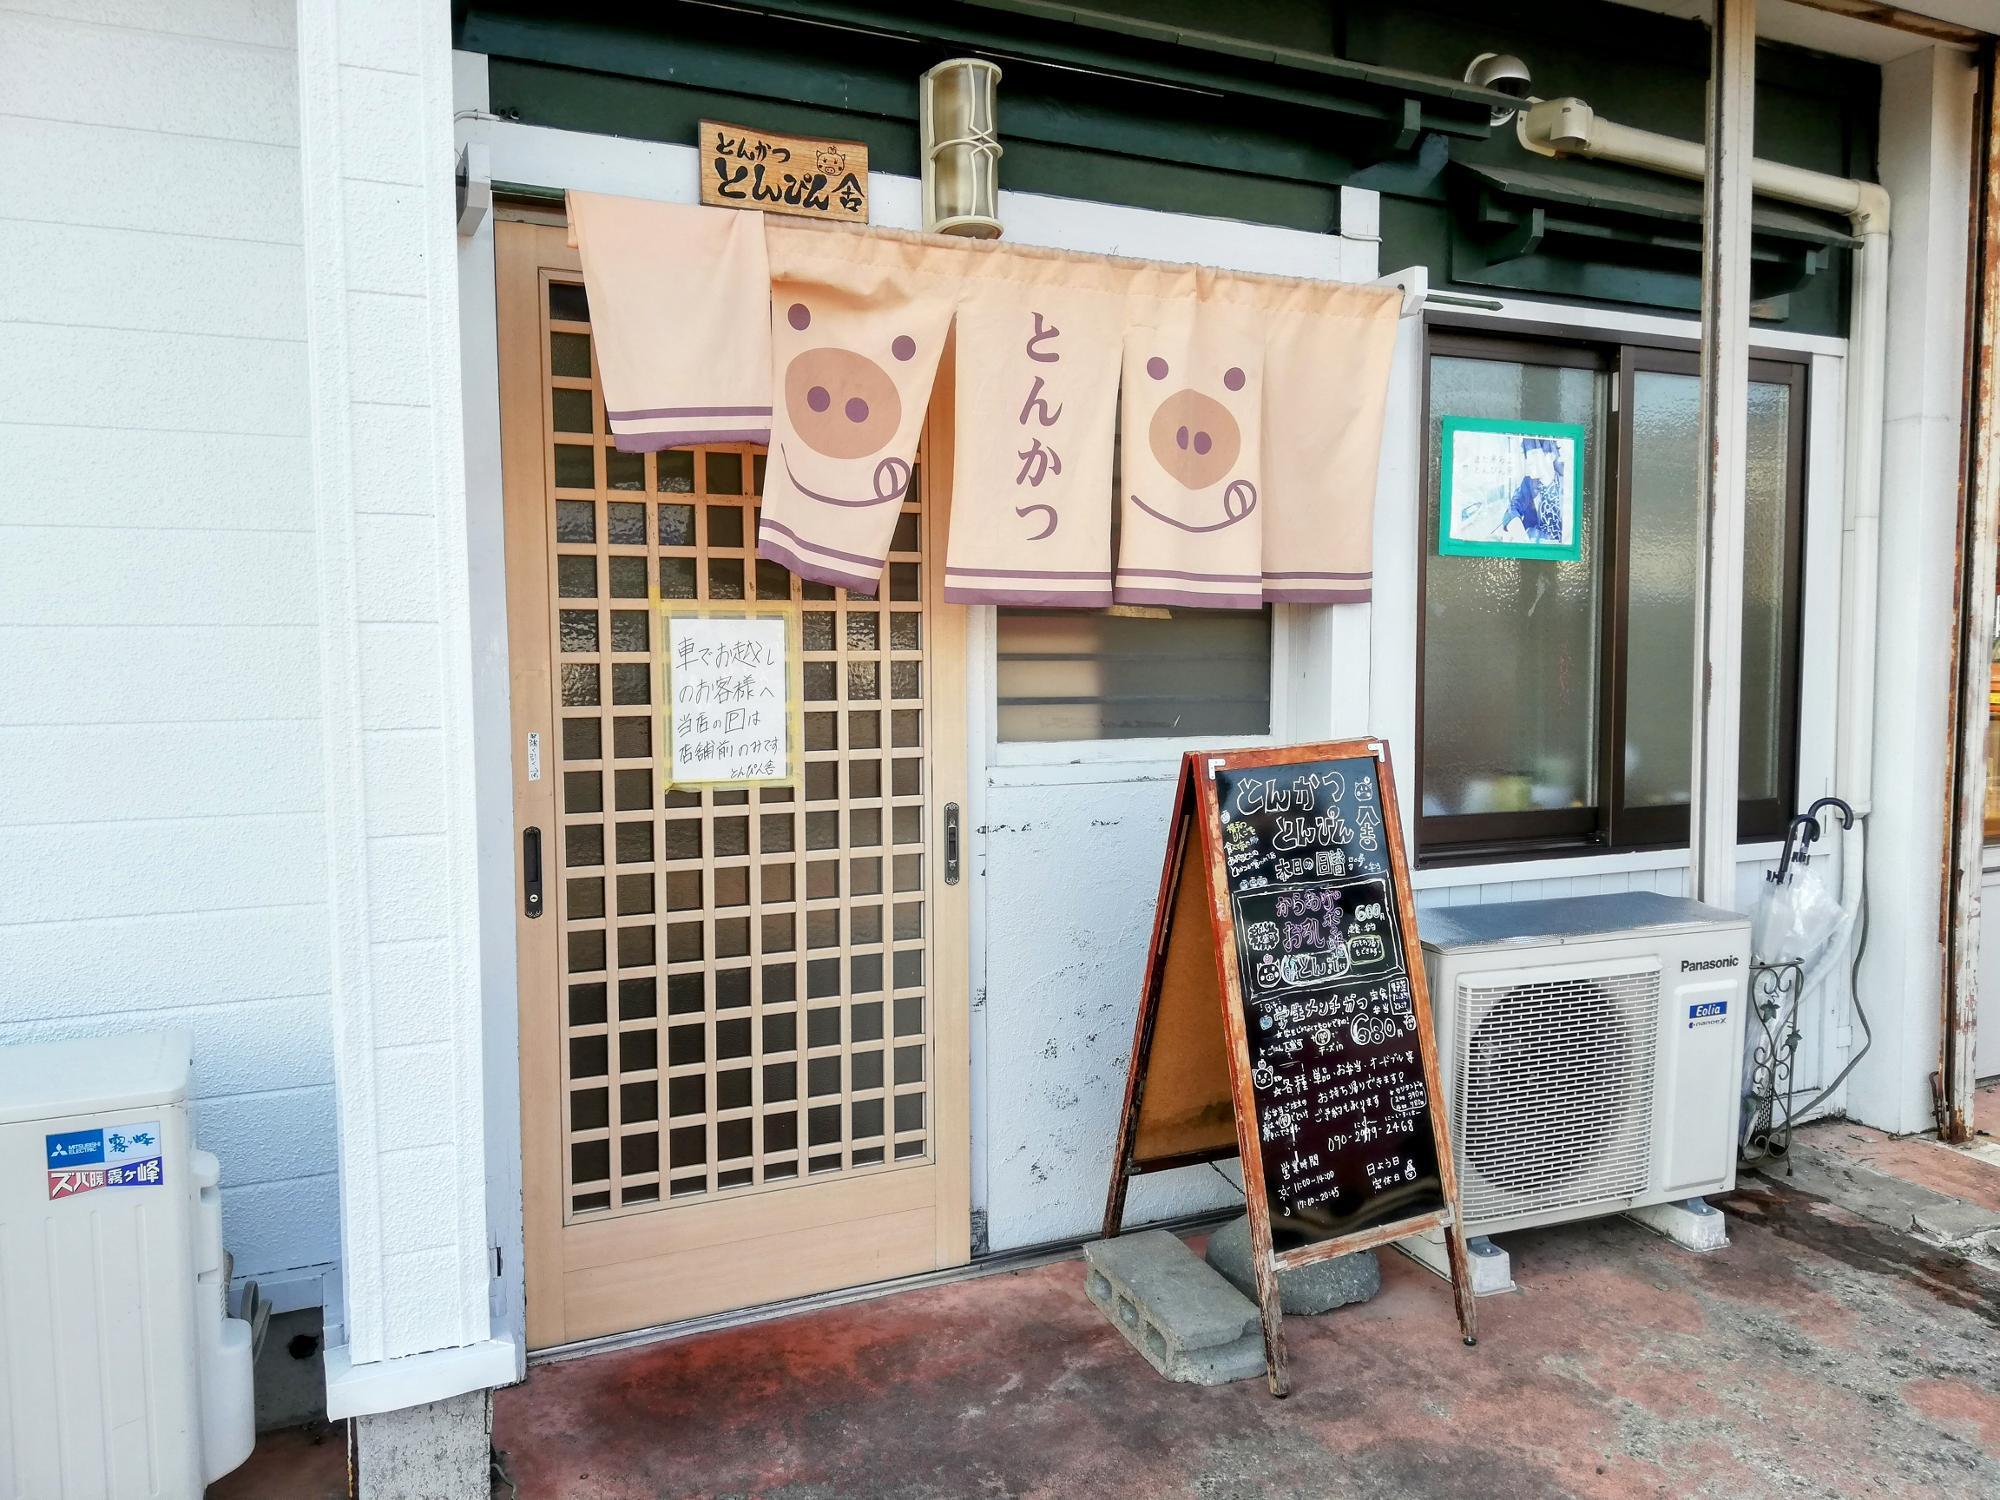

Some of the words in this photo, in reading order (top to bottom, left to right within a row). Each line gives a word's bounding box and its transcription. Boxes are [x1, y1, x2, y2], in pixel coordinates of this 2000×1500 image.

[715, 131, 791, 164] とんかつ
[1015, 311, 1064, 541] とんかつ
[676, 636, 775, 671] 車でお越し
[679, 674, 775, 704] のお客様へ
[679, 736, 780, 765] 店舗前のみです
[1236, 771, 1345, 816] とんかつ
[1681, 954, 1739, 972] Panasonic
[1695, 1003, 1720, 1017] Eolia
[68, 1141, 101, 1150] MITSUBISHI
[68, 1147, 97, 1155] ELECTRIC
[1280, 1153, 1319, 1180] 営業時間
[1366, 1155, 1400, 1176] 日よう日
[1372, 1173, 1400, 1190] 定休日
